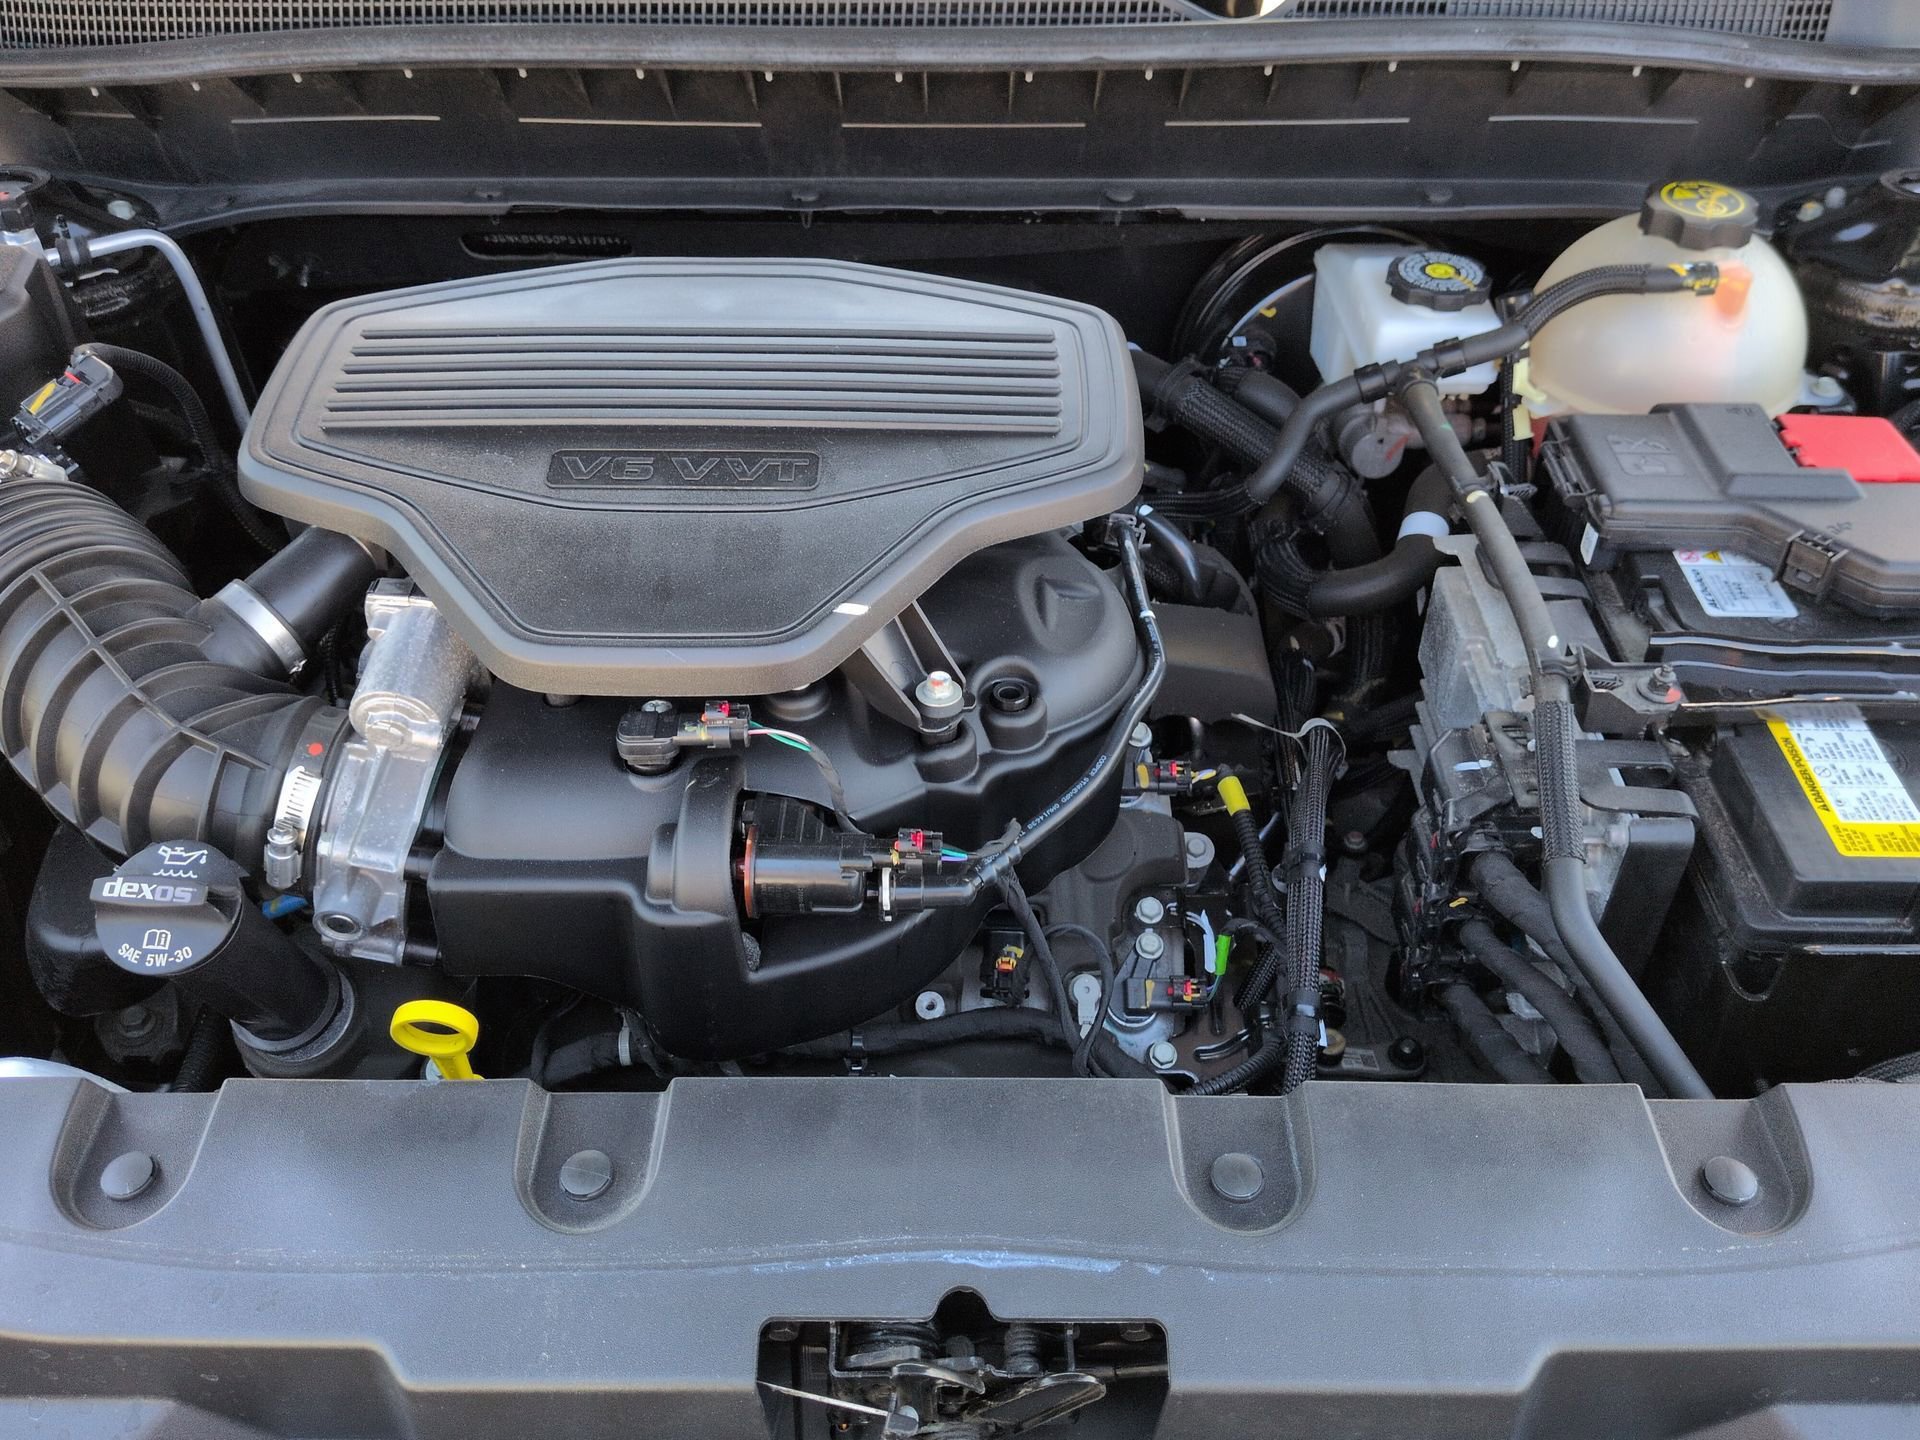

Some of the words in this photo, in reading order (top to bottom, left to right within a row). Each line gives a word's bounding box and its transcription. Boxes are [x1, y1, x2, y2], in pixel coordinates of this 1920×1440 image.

[561, 456, 655, 480] V6
[671, 456, 811, 481] VVT
[1780, 736, 1807, 768] POISON
[1799, 768, 1825, 805] DANGER
[102, 876, 195, 904] dexos
[118, 943, 143, 965] SAE
[145, 946, 194, 968] 5W-30
